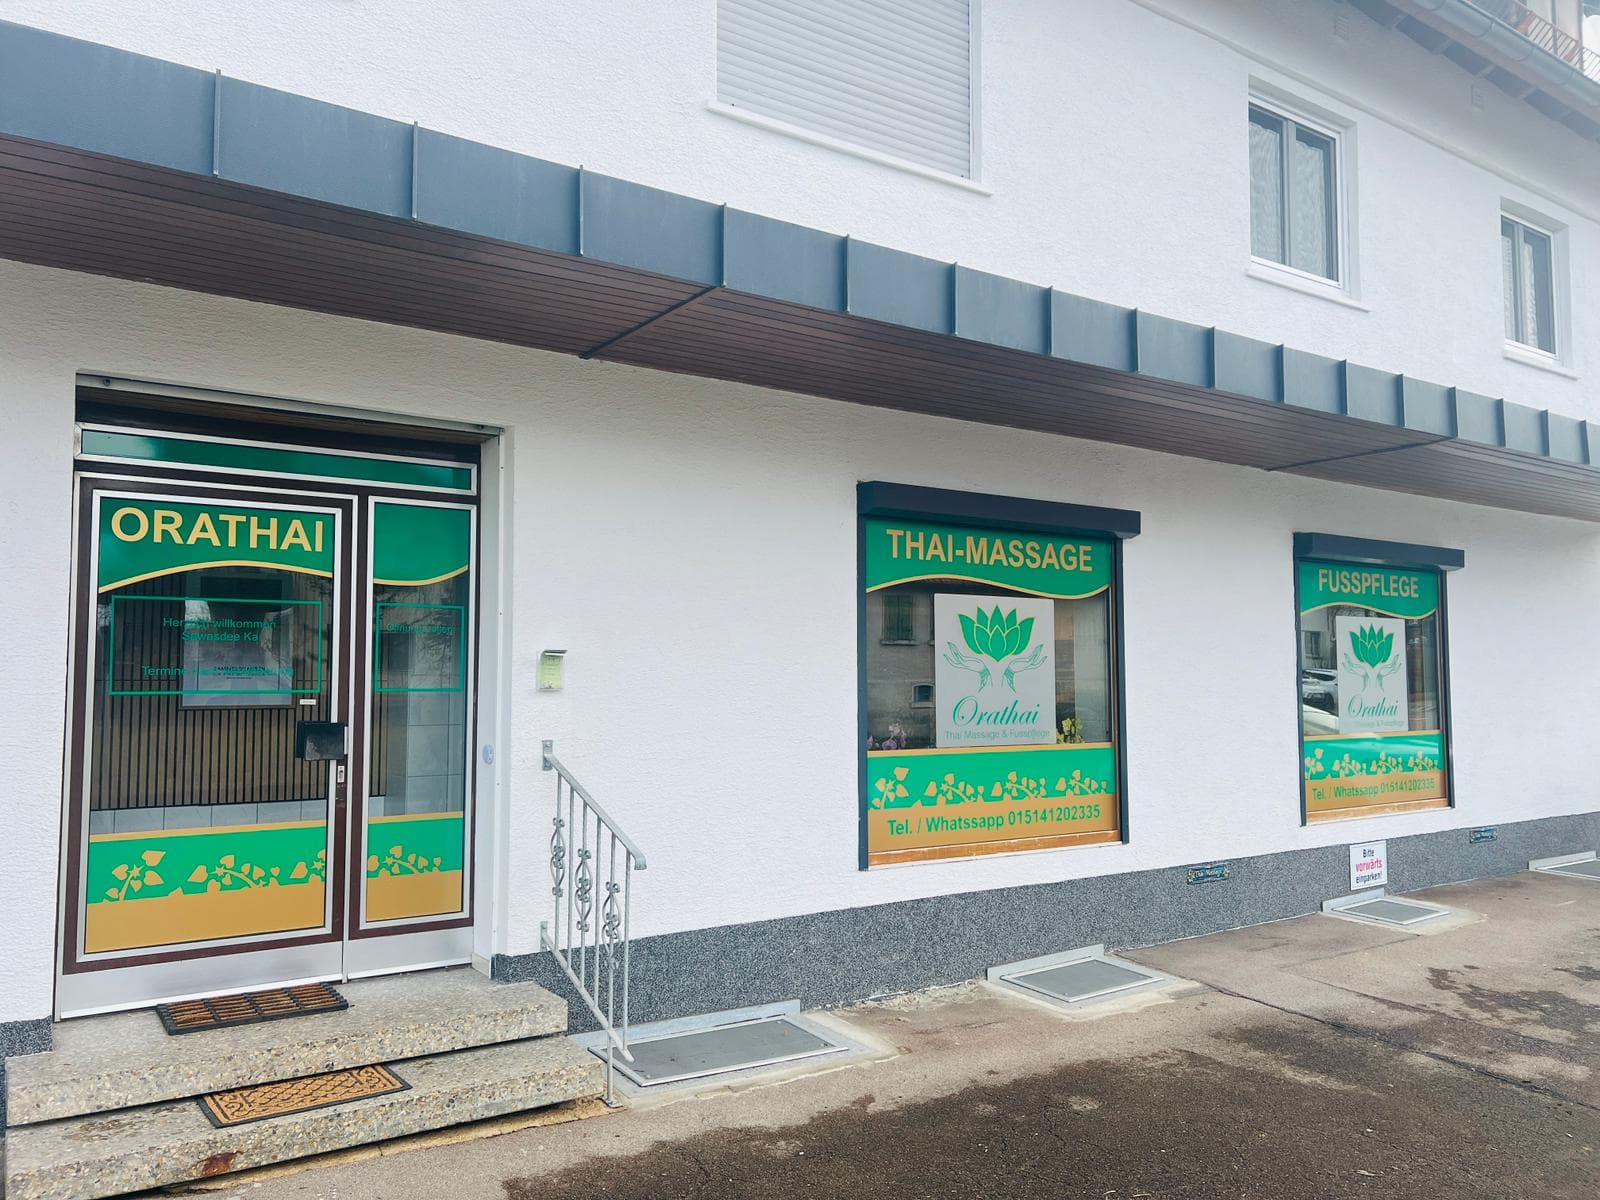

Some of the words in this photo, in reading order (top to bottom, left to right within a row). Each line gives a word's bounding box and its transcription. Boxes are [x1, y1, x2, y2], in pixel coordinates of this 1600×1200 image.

[111, 507, 323, 552] ORATHAI
[886, 529, 1093, 571] THAI-MASSAGE
[1318, 568, 1419, 598] FUSSPFLEGE
[182, 632, 240, 641] Sawasdee
[213, 618, 276, 629] willkommen
[952, 696, 1040, 726] Orathai
[1347, 694, 1399, 718] Orathai
[945, 730, 960, 739] Thai
[963, 730, 999, 740] Massage
[1002, 730, 1008, 738] &
[1333, 785, 1378, 798] Whatssapp
[888, 819, 912, 835] Tel.
[926, 814, 1004, 833] Whatssapp
[1008, 804, 1100, 826] 015141202335
